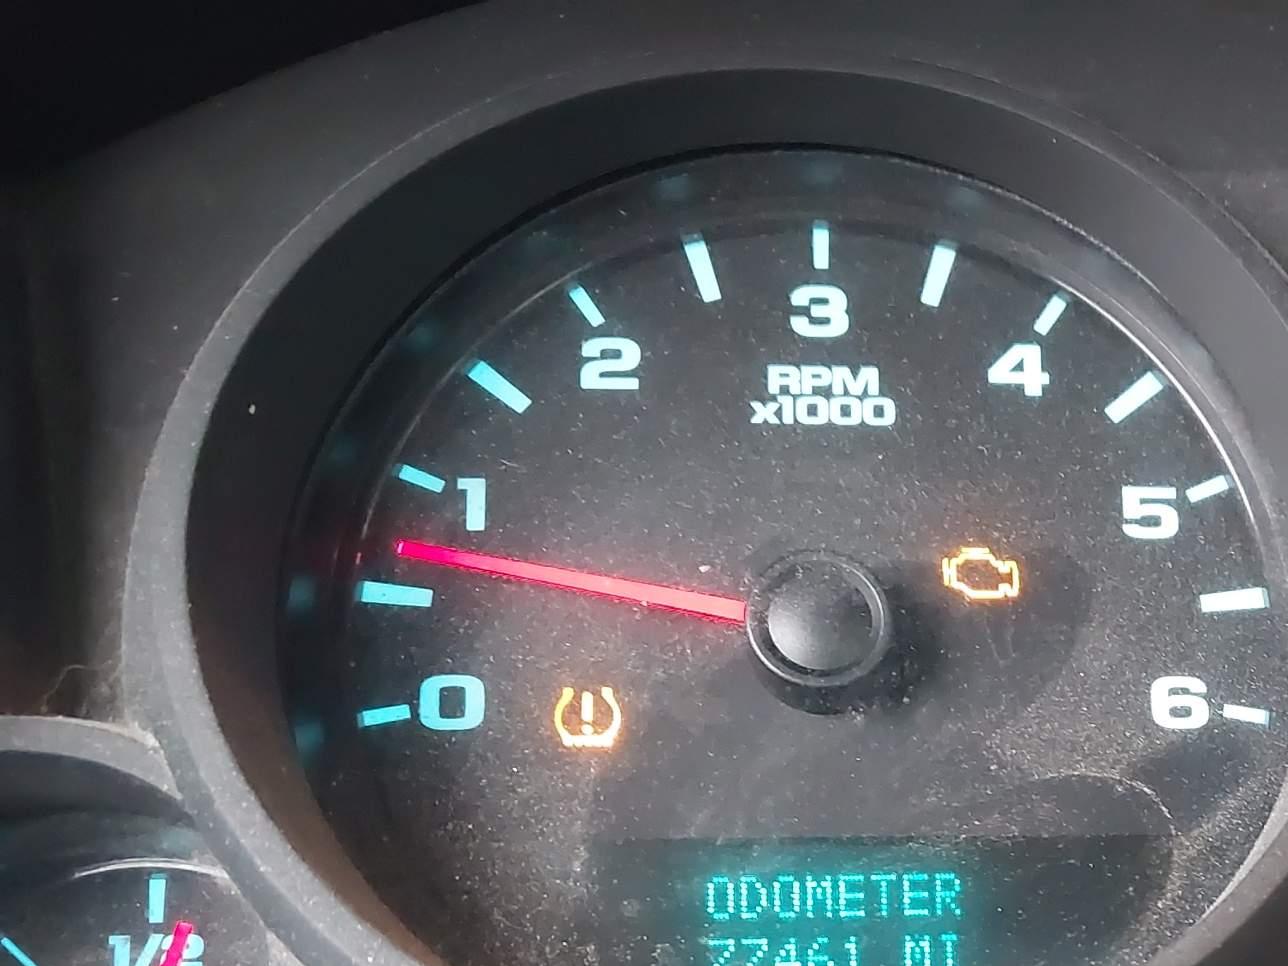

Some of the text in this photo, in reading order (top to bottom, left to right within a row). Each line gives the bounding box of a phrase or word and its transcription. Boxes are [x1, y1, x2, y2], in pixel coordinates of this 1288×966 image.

[790, 285, 849, 337] 3
[580, 337, 641, 389] 2
[767, 365, 879, 395] RPM
[988, 343, 1049, 396] 4
[750, 398, 895, 426] x1000
[458, 478, 486, 531] 1
[1122, 485, 1179, 539] 5
[419, 675, 485, 730] 0
[1150, 676, 1209, 731] 6
[706, 871, 962, 920] ODOMETER
